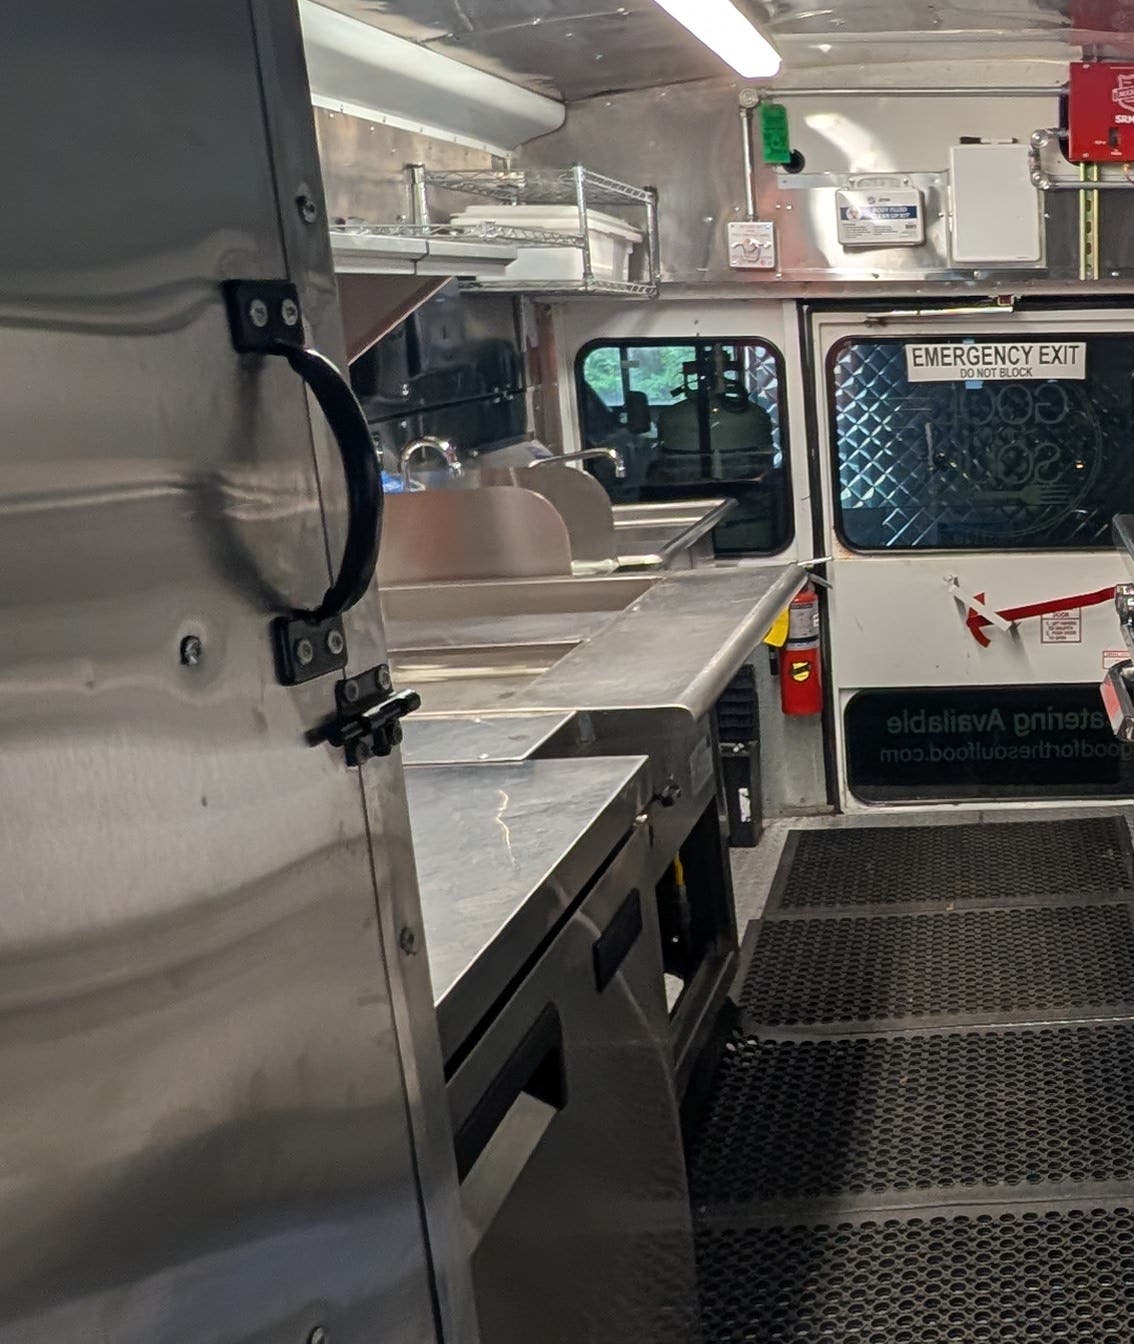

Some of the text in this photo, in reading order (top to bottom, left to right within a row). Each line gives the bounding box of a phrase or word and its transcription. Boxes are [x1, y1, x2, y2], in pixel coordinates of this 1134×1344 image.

[912, 345, 1080, 367] EMERGENCY EXIT
[960, 367, 1033, 378] DO NOT BLOCK
